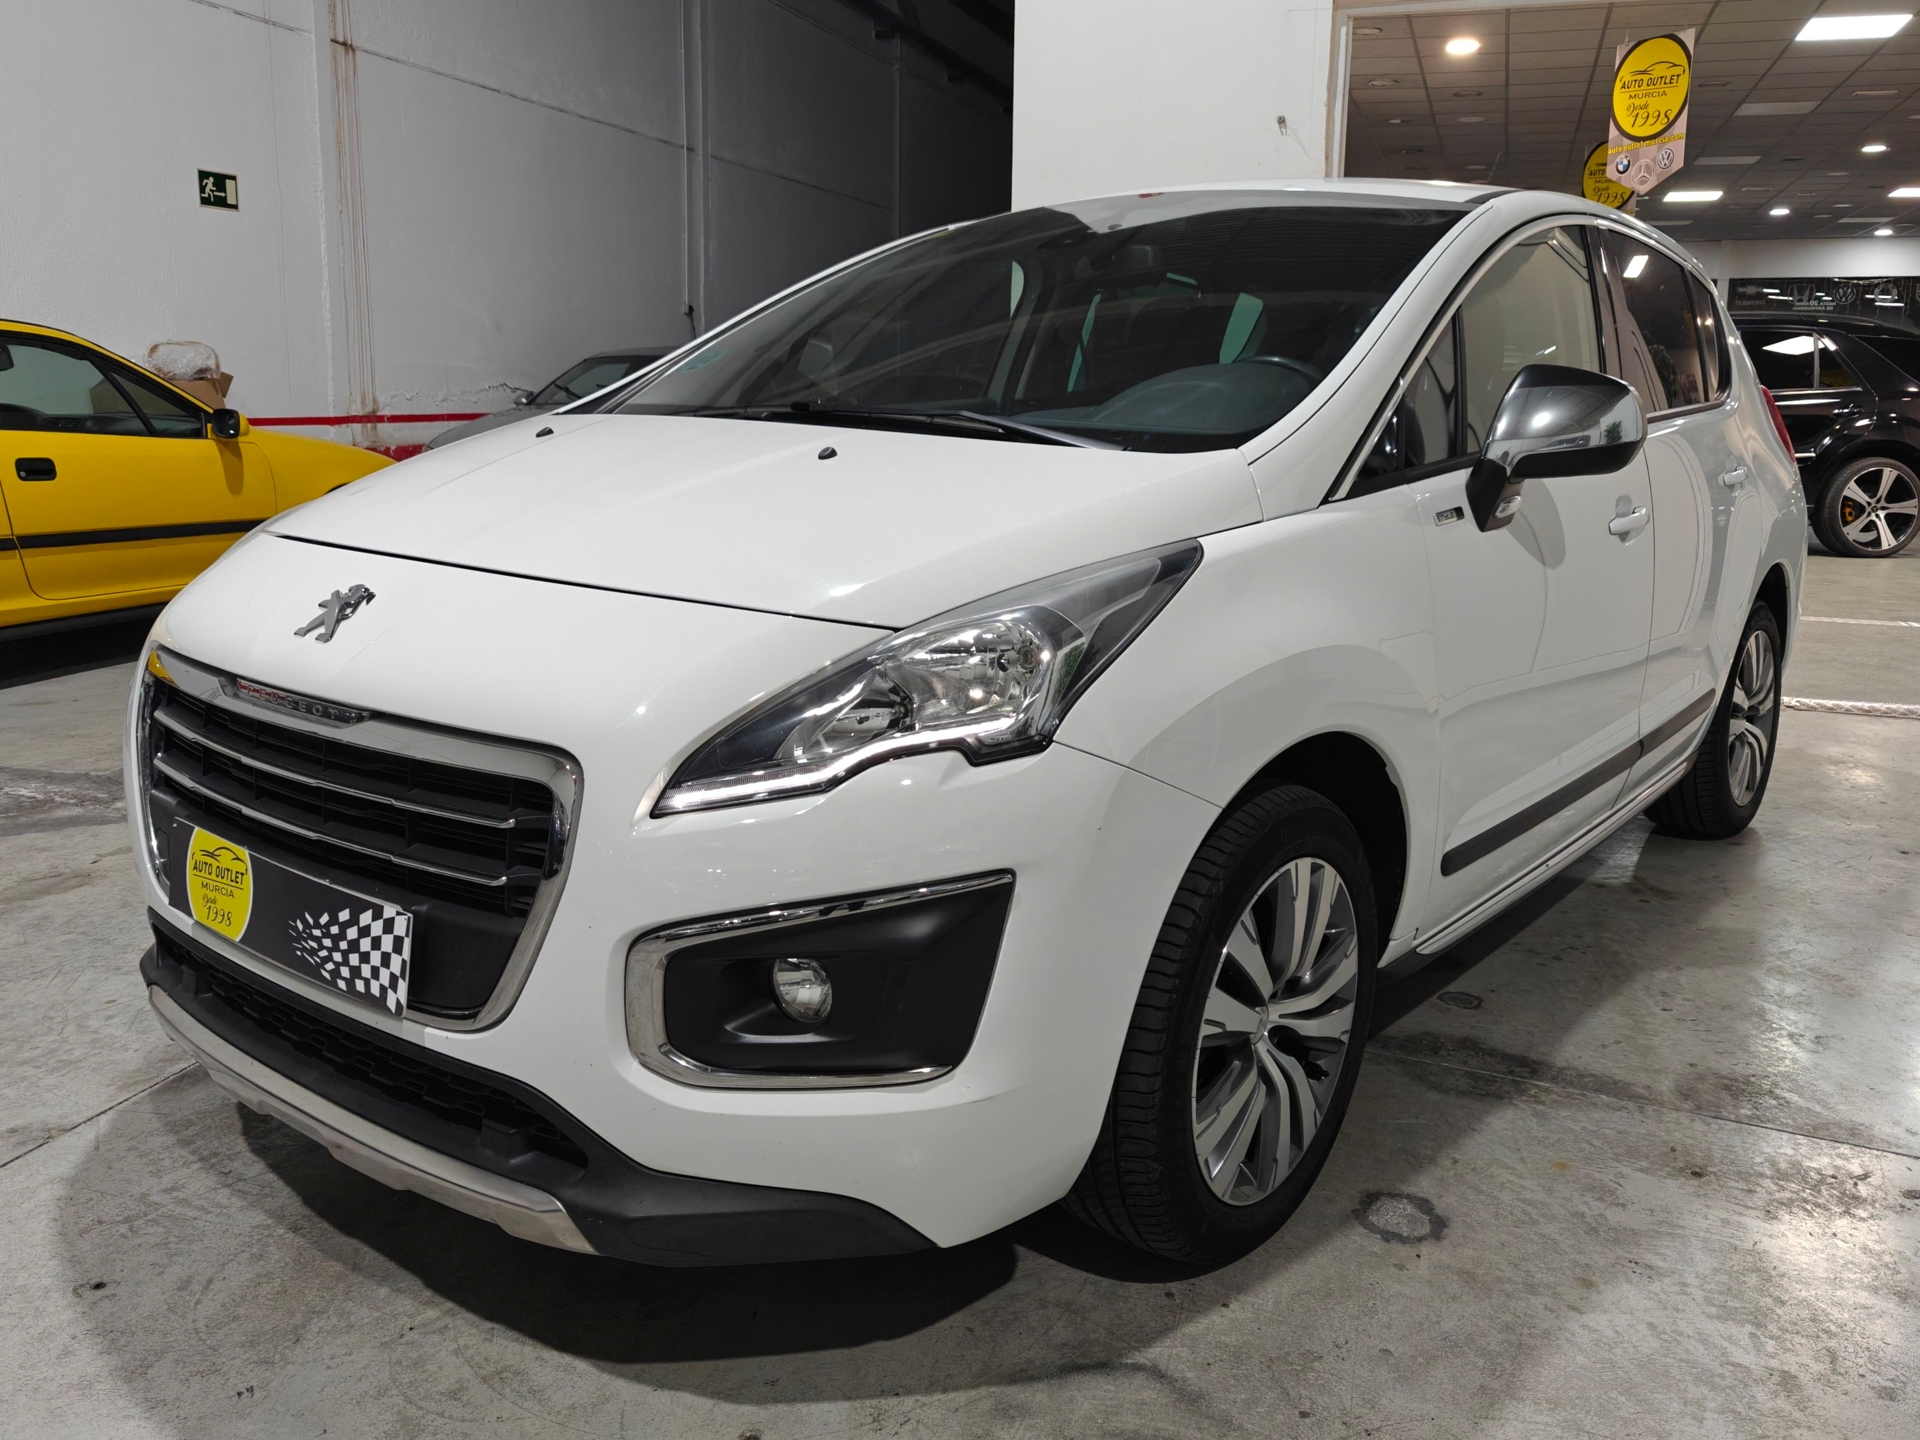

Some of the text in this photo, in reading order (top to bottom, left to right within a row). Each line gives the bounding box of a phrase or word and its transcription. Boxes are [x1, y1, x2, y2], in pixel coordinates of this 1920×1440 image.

[1620, 74, 1682, 91] AUTO OUTLET
[1628, 90, 1668, 101] MURCIA
[1626, 100, 1650, 118] Desde
[1631, 108, 1673, 128] 1998
[1607, 145, 1622, 155] auto
[246, 684, 340, 720] PEUGEOT
[192, 858, 245, 886] AUTO OUTLET
[201, 881, 235, 899] MURCIA
[206, 904, 233, 927] 1998
